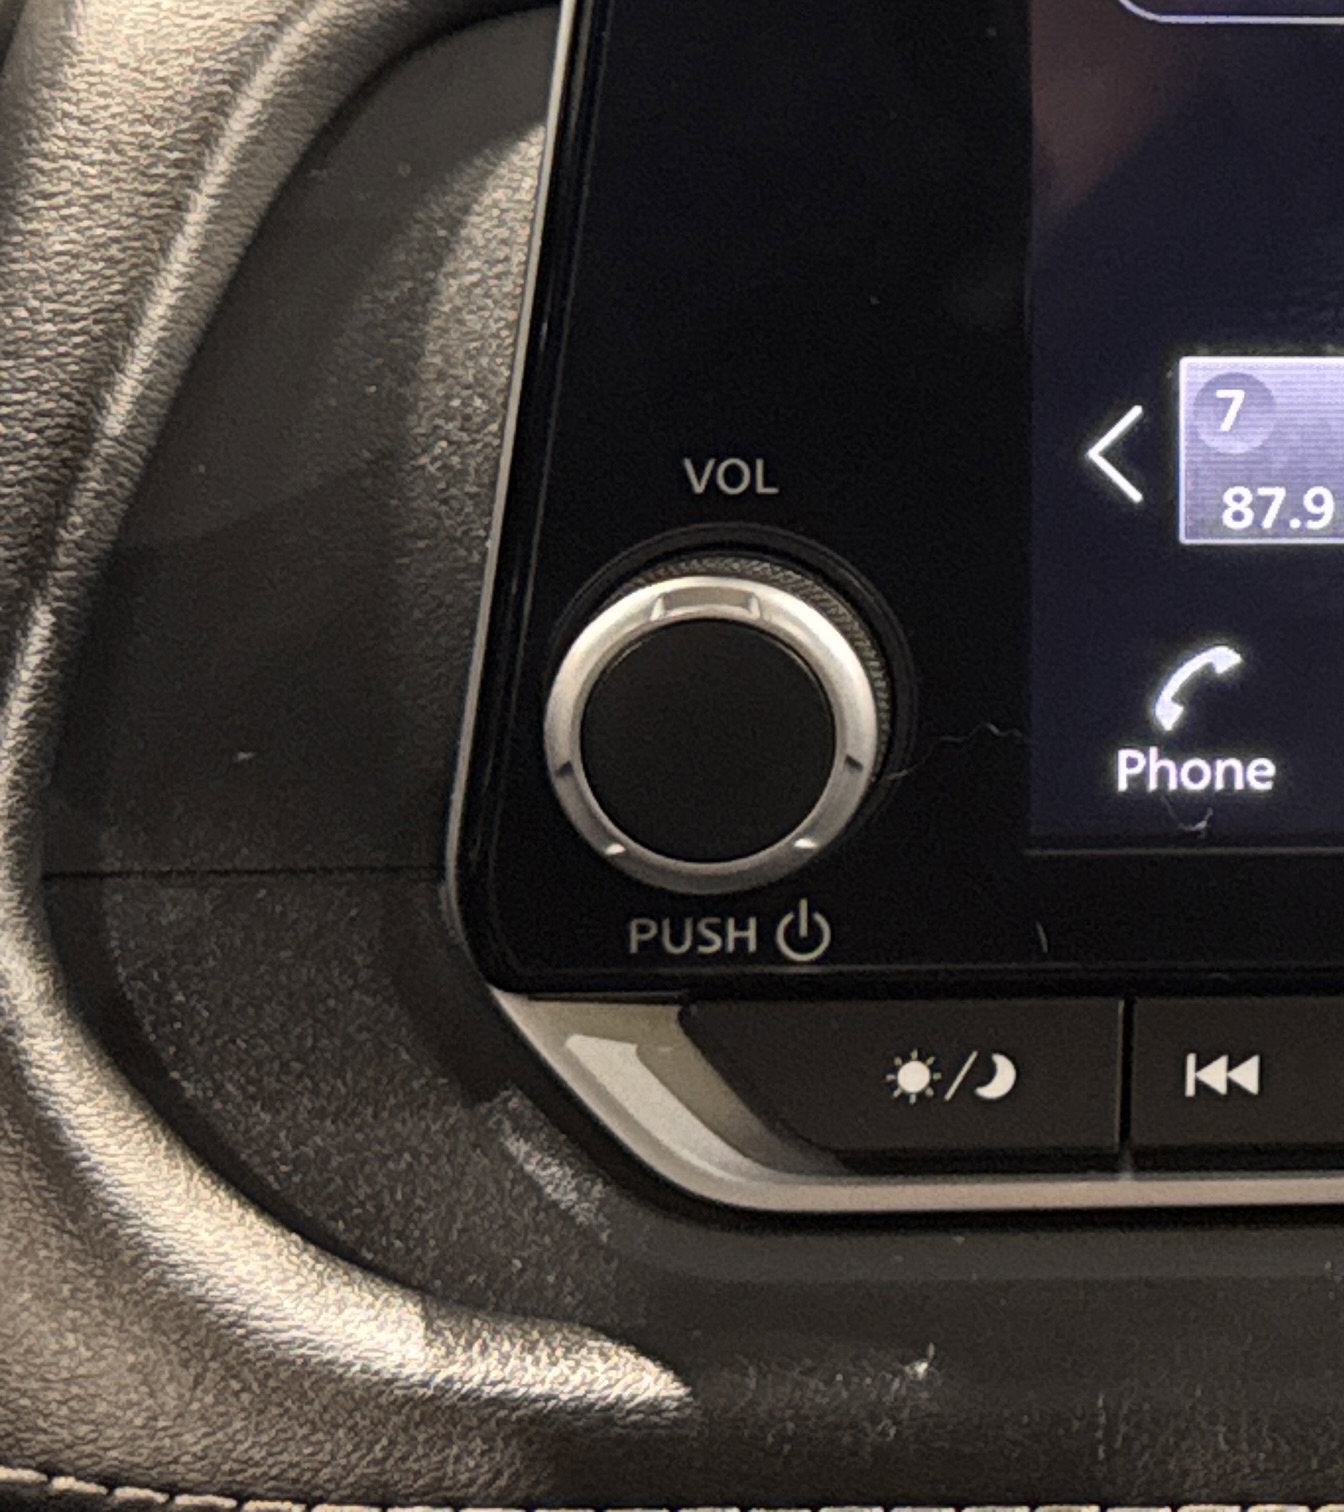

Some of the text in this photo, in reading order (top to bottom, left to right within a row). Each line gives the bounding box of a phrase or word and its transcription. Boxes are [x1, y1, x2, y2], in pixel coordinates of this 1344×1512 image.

[1215, 389, 1245, 432] 7
[684, 457, 779, 496] VOL
[1221, 486, 1335, 530] 87.9
[1116, 748, 1276, 792] Phone
[628, 917, 757, 954] PUSH
